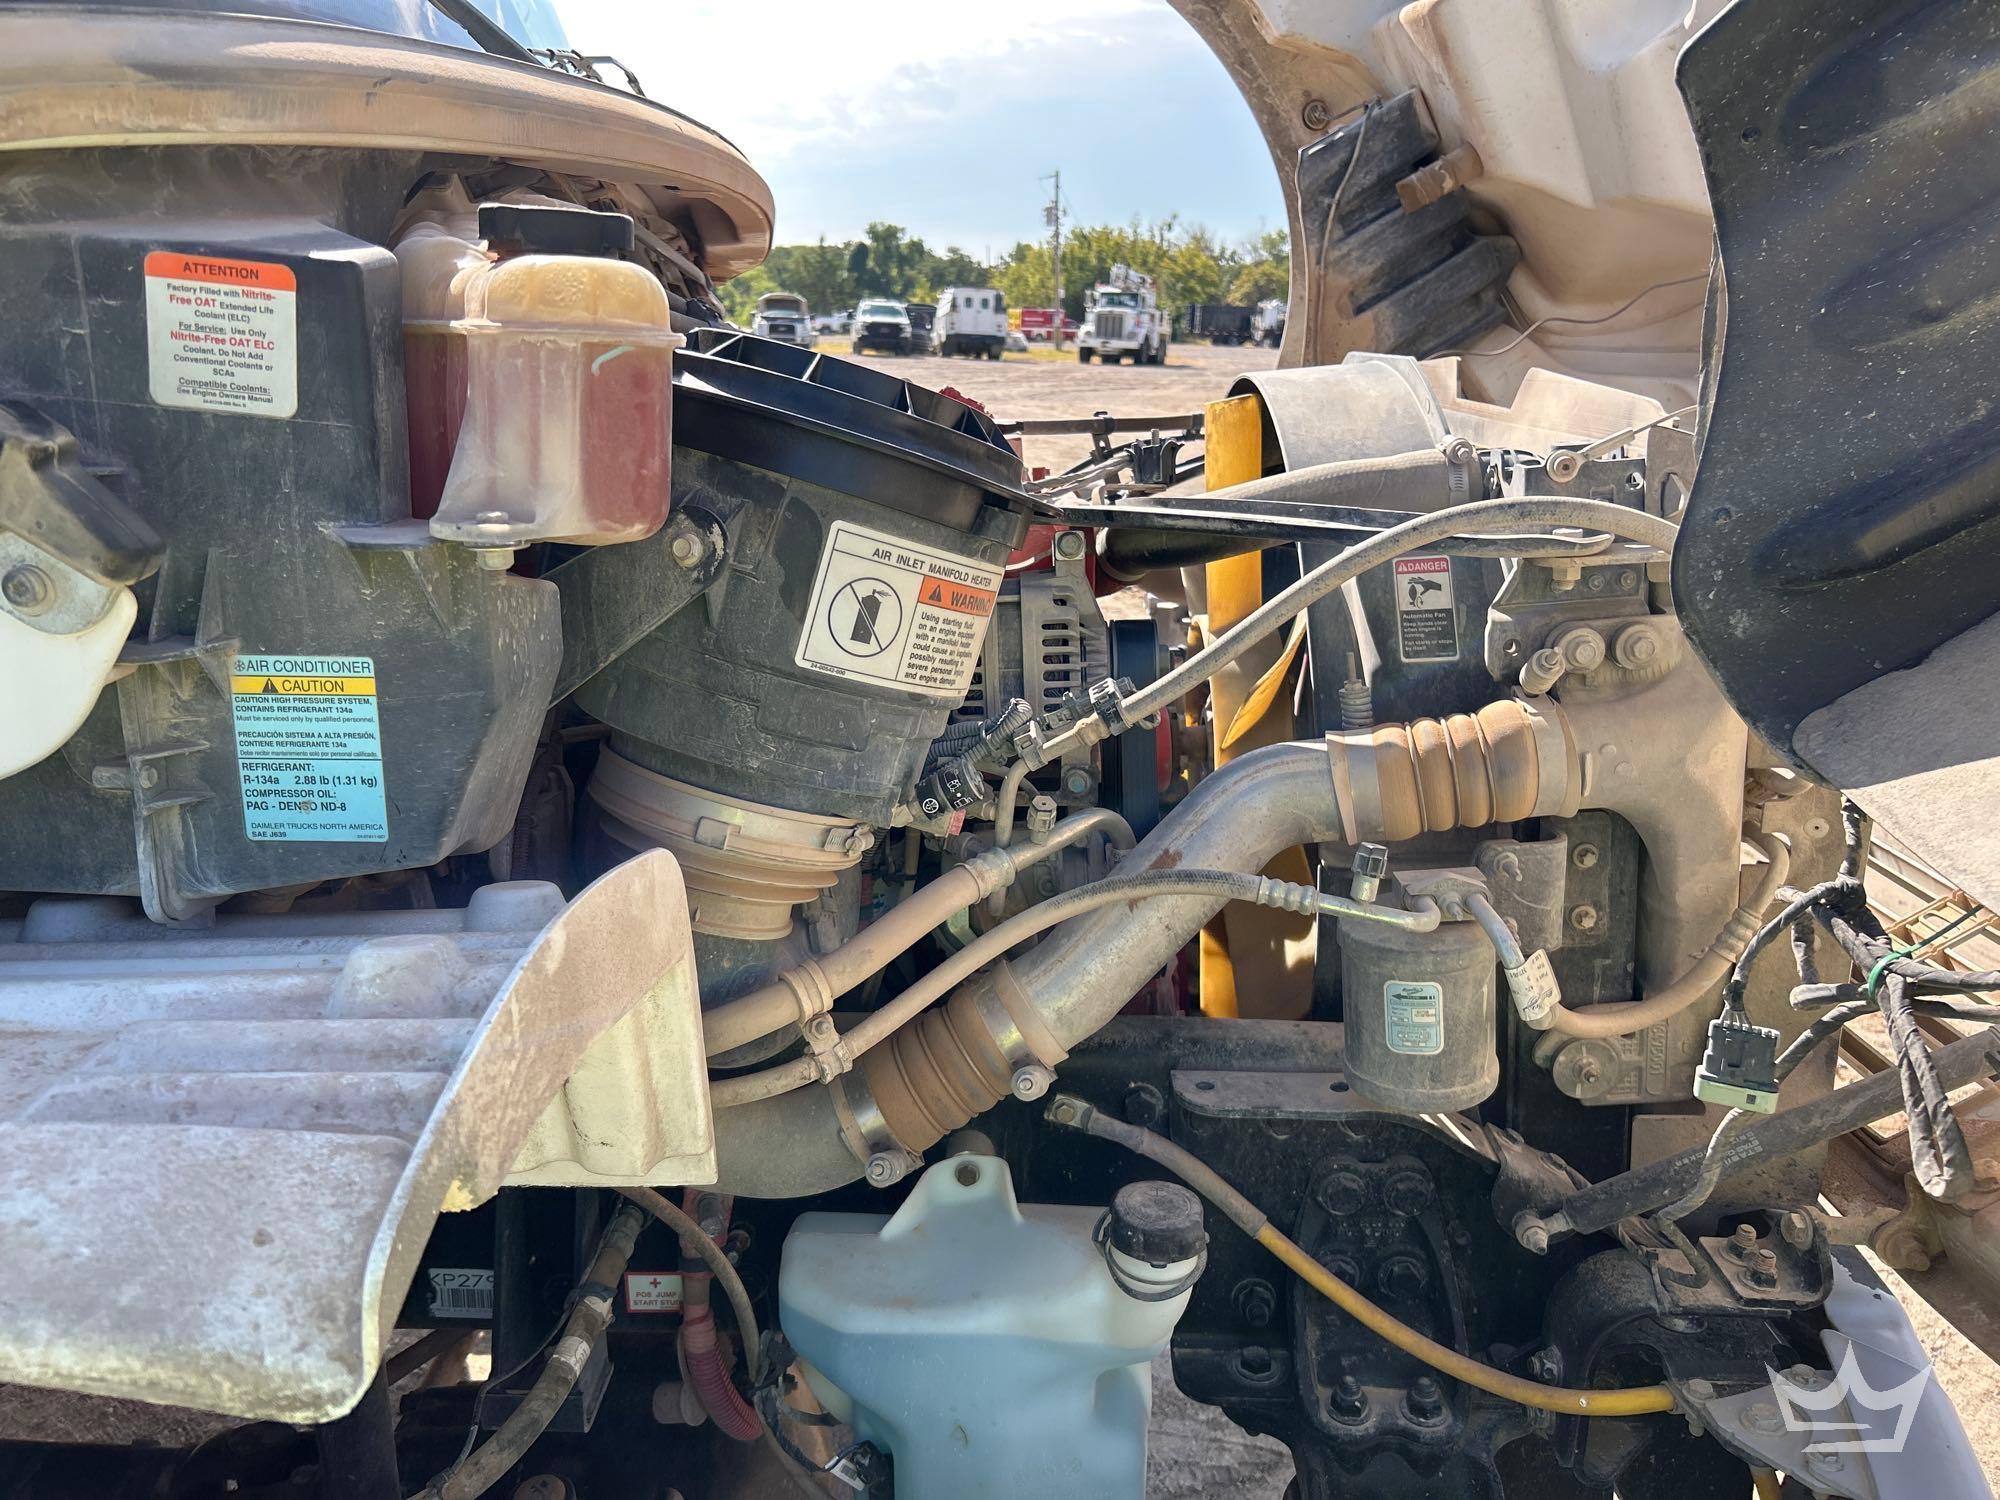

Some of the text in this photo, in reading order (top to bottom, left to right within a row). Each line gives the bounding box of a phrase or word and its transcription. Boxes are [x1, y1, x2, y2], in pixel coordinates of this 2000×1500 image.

[183, 262, 258, 280] ATTENTION
[167, 283, 276, 300] Factory Filled with Nitrite-
[170, 294, 274, 314] Free OAT Extended Life
[194, 310, 250, 324] Coolant (ELC)
[178, 322, 266, 339] For Service: Use Only
[170, 330, 274, 350] Nitrite-Free OAT ELC
[183, 344, 264, 360] Coolant. Do Not Add
[174, 354, 226, 366] Conventional
[228, 360, 263, 370] Coolants
[212, 368, 234, 378] SCAs
[178, 377, 270, 394] Compatible Coolants:
[192, 388, 216, 398] Engine
[218, 391, 246, 400] Owners
[248, 395, 273, 404] Manual
[872, 548, 992, 587] AIR INLET MANIFOLD HEATER
[1408, 561, 1448, 570] DANGER
[951, 591, 990, 612] WARNING
[921, 612, 940, 625] Using
[942, 617, 963, 630] starting
[938, 628, 956, 637] engine
[916, 633, 929, 641] with
[936, 638, 959, 647] manifold
[912, 642, 930, 652] could
[932, 647, 948, 656] cause
[246, 660, 371, 674] AIR CONDITIONER
[910, 652, 936, 664] possibly
[938, 658, 960, 668] resulting
[907, 662, 928, 672] severe
[930, 666, 952, 676] personal
[904, 672, 918, 680] and
[919, 674, 938, 684] engine
[282, 680, 344, 692] CAUTION
[343, 732, 376, 740] PRESIÓN,
[242, 762, 314, 772] REFRIGERANT:
[244, 774, 377, 788] R-134a 2.88 lb (1.31 kg)
[245, 789, 336, 798] COMPRESSOR OIL:
[246, 801, 270, 810] PAG
[278, 801, 318, 811] DENSO
[321, 802, 346, 812] ND-8
